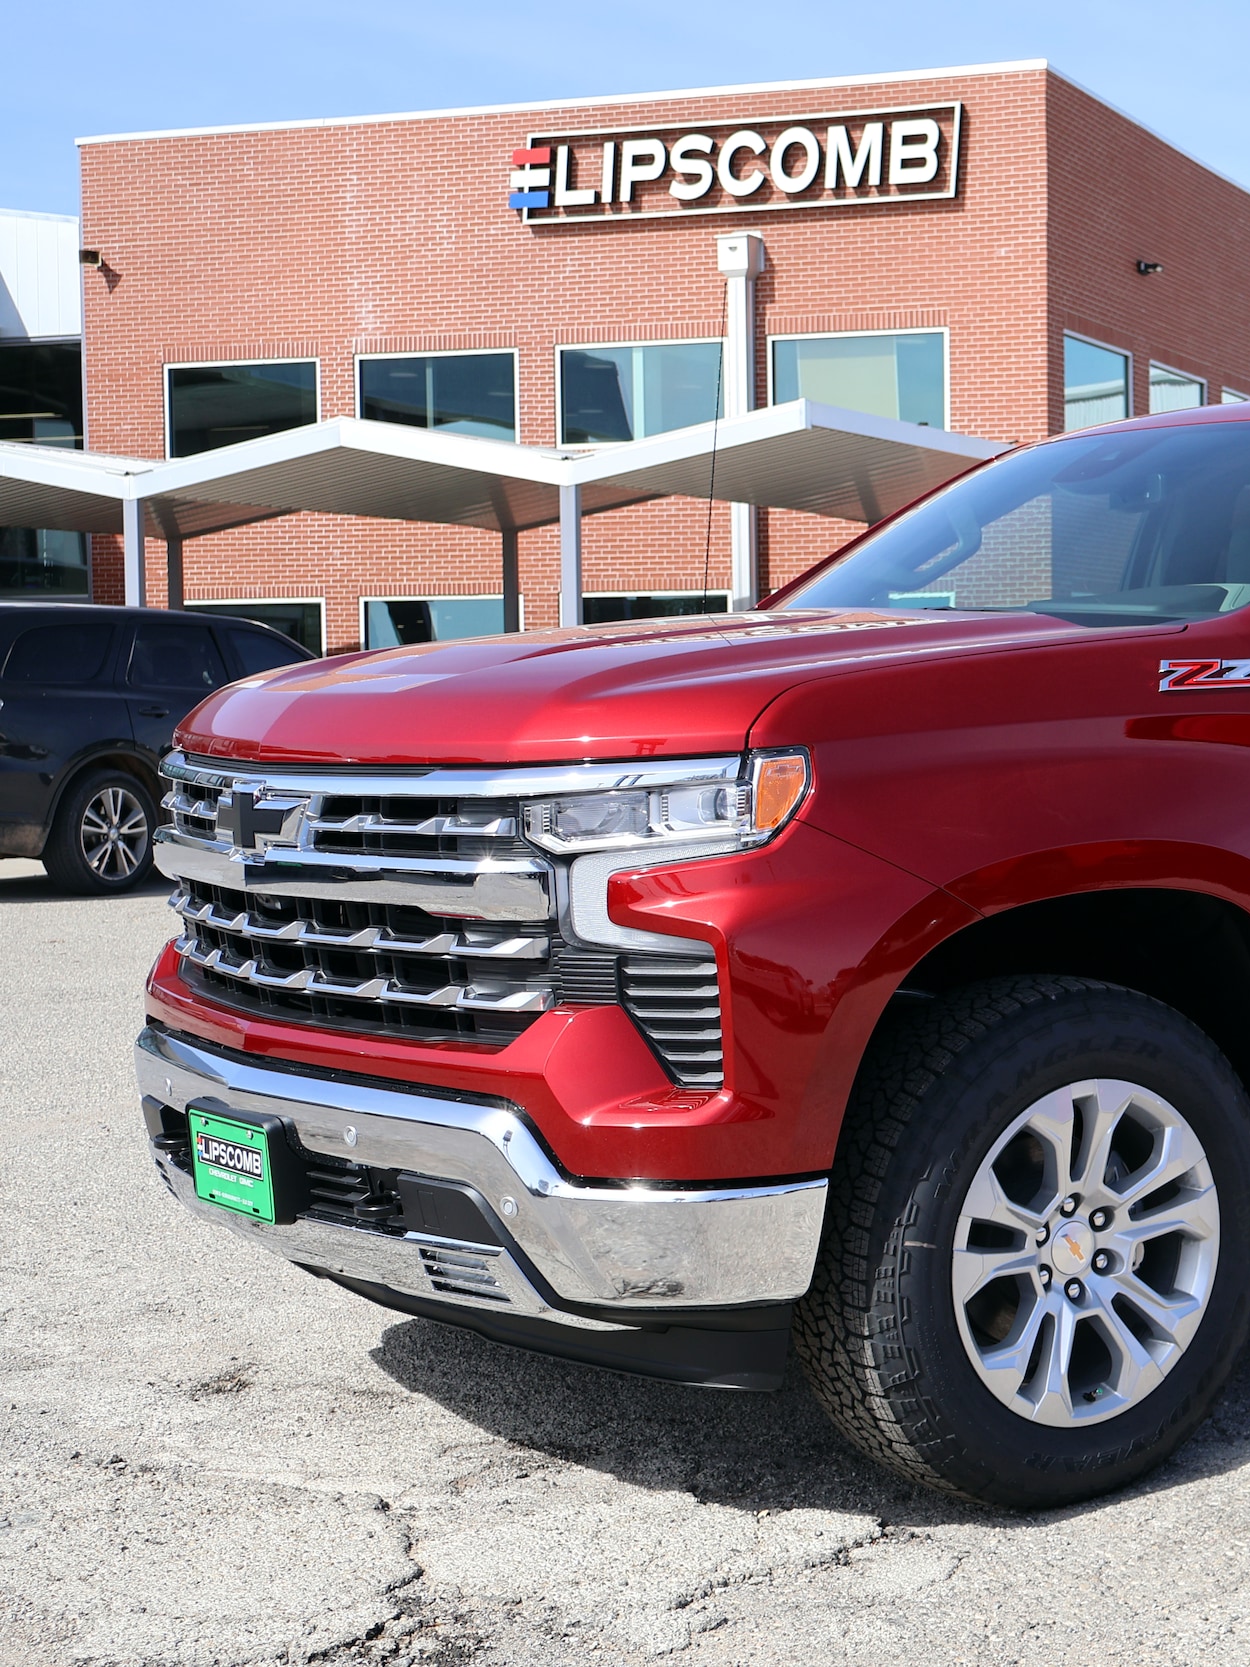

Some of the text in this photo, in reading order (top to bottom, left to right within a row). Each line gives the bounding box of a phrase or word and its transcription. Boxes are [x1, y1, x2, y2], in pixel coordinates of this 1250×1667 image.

[555, 118, 941, 206] LIPSCOMB
[203, 1138, 262, 1174] LIPSCOMB
[209, 1168, 237, 1183] CHEVROLET
